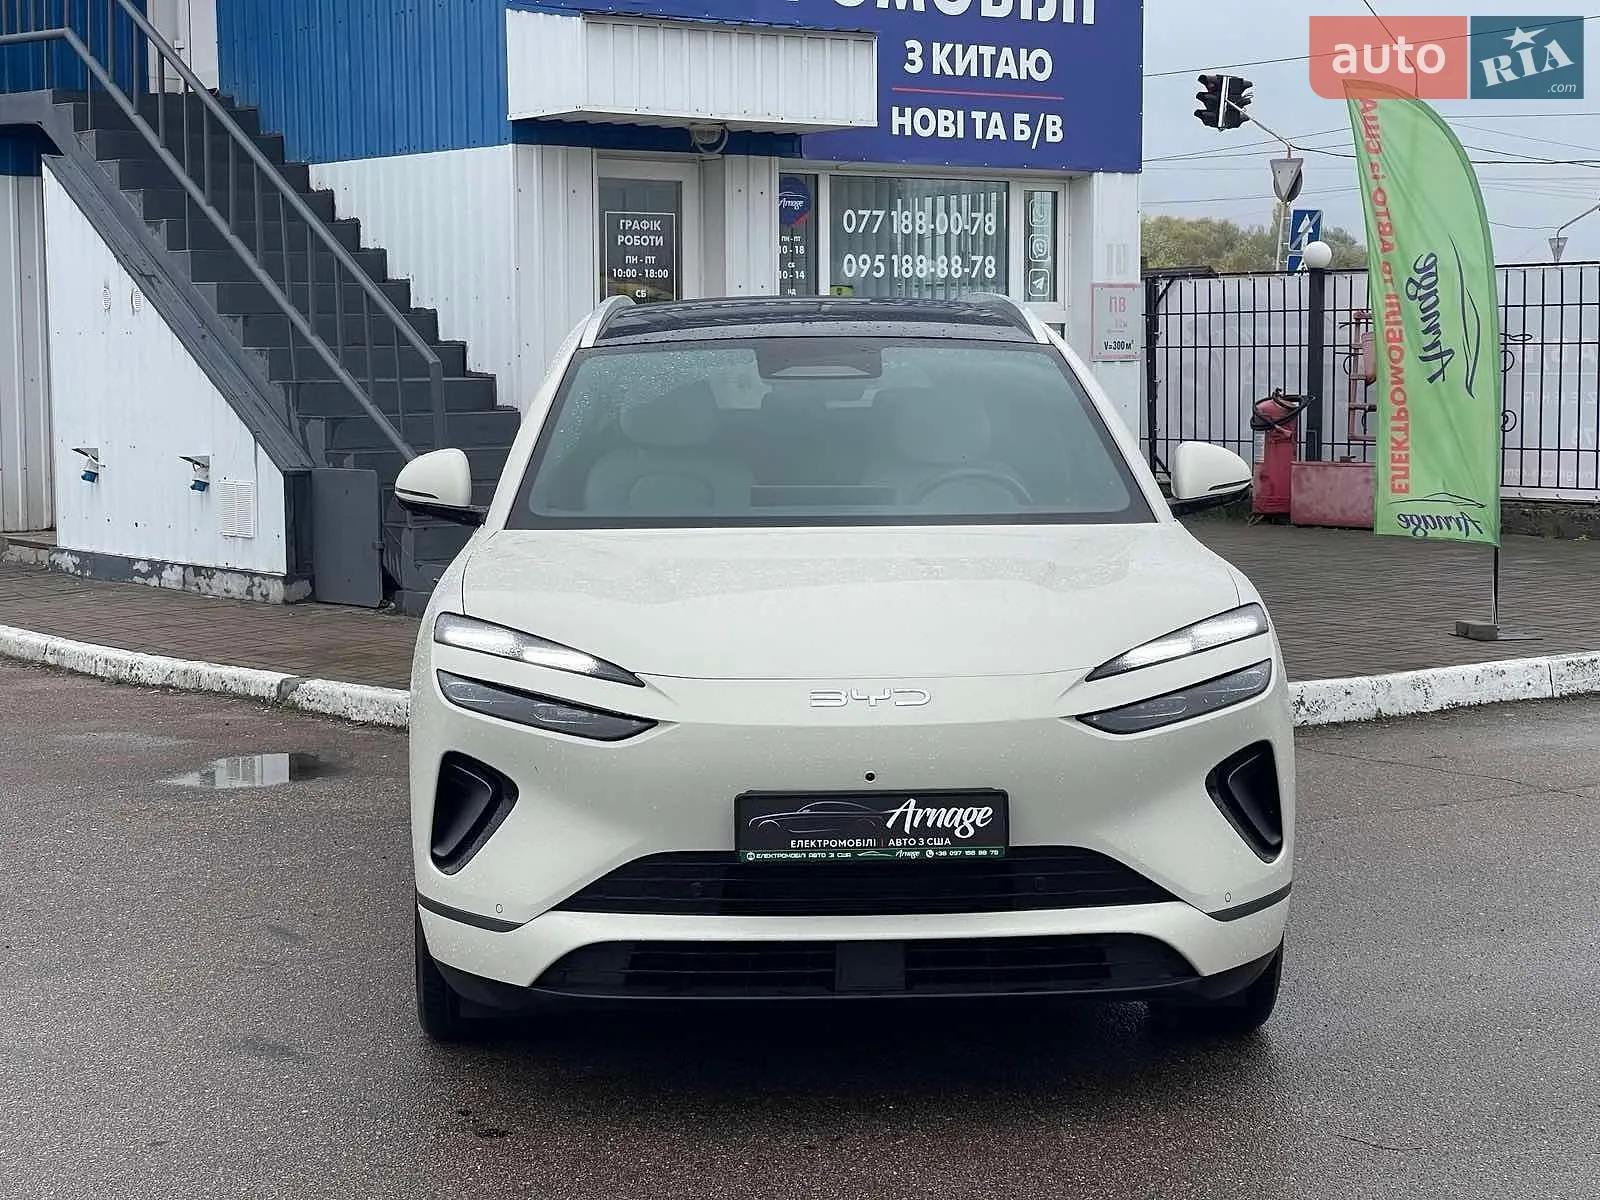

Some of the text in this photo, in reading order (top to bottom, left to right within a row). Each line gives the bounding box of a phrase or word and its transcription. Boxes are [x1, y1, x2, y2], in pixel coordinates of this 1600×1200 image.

[903, 40, 1053, 82] З КИТАЮ
[892, 107, 1065, 149] НОВІ ТА Б/В
[619, 219, 661, 231] ГРАФІК
[843, 209, 996, 236] 077 188-00-78
[617, 235, 664, 246] РОБОТИ
[794, 245, 805, 254] 18
[625, 255, 638, 264] ПН
[644, 255, 656, 264] ПТ
[843, 253, 996, 279] 095 188-88-78
[612, 268, 637, 278] 10:00
[644, 269, 669, 278] 18:00
[795, 270, 805, 280] 14
[635, 289, 647, 298] СБ
[808, 688, 931, 707] BYD
[886, 798, 993, 838] Arnage
[790, 839, 876, 849] ЕЛЕКТРОМОБІЛІ
[888, 838, 916, 847] АВТО
[926, 837, 951, 846] США
